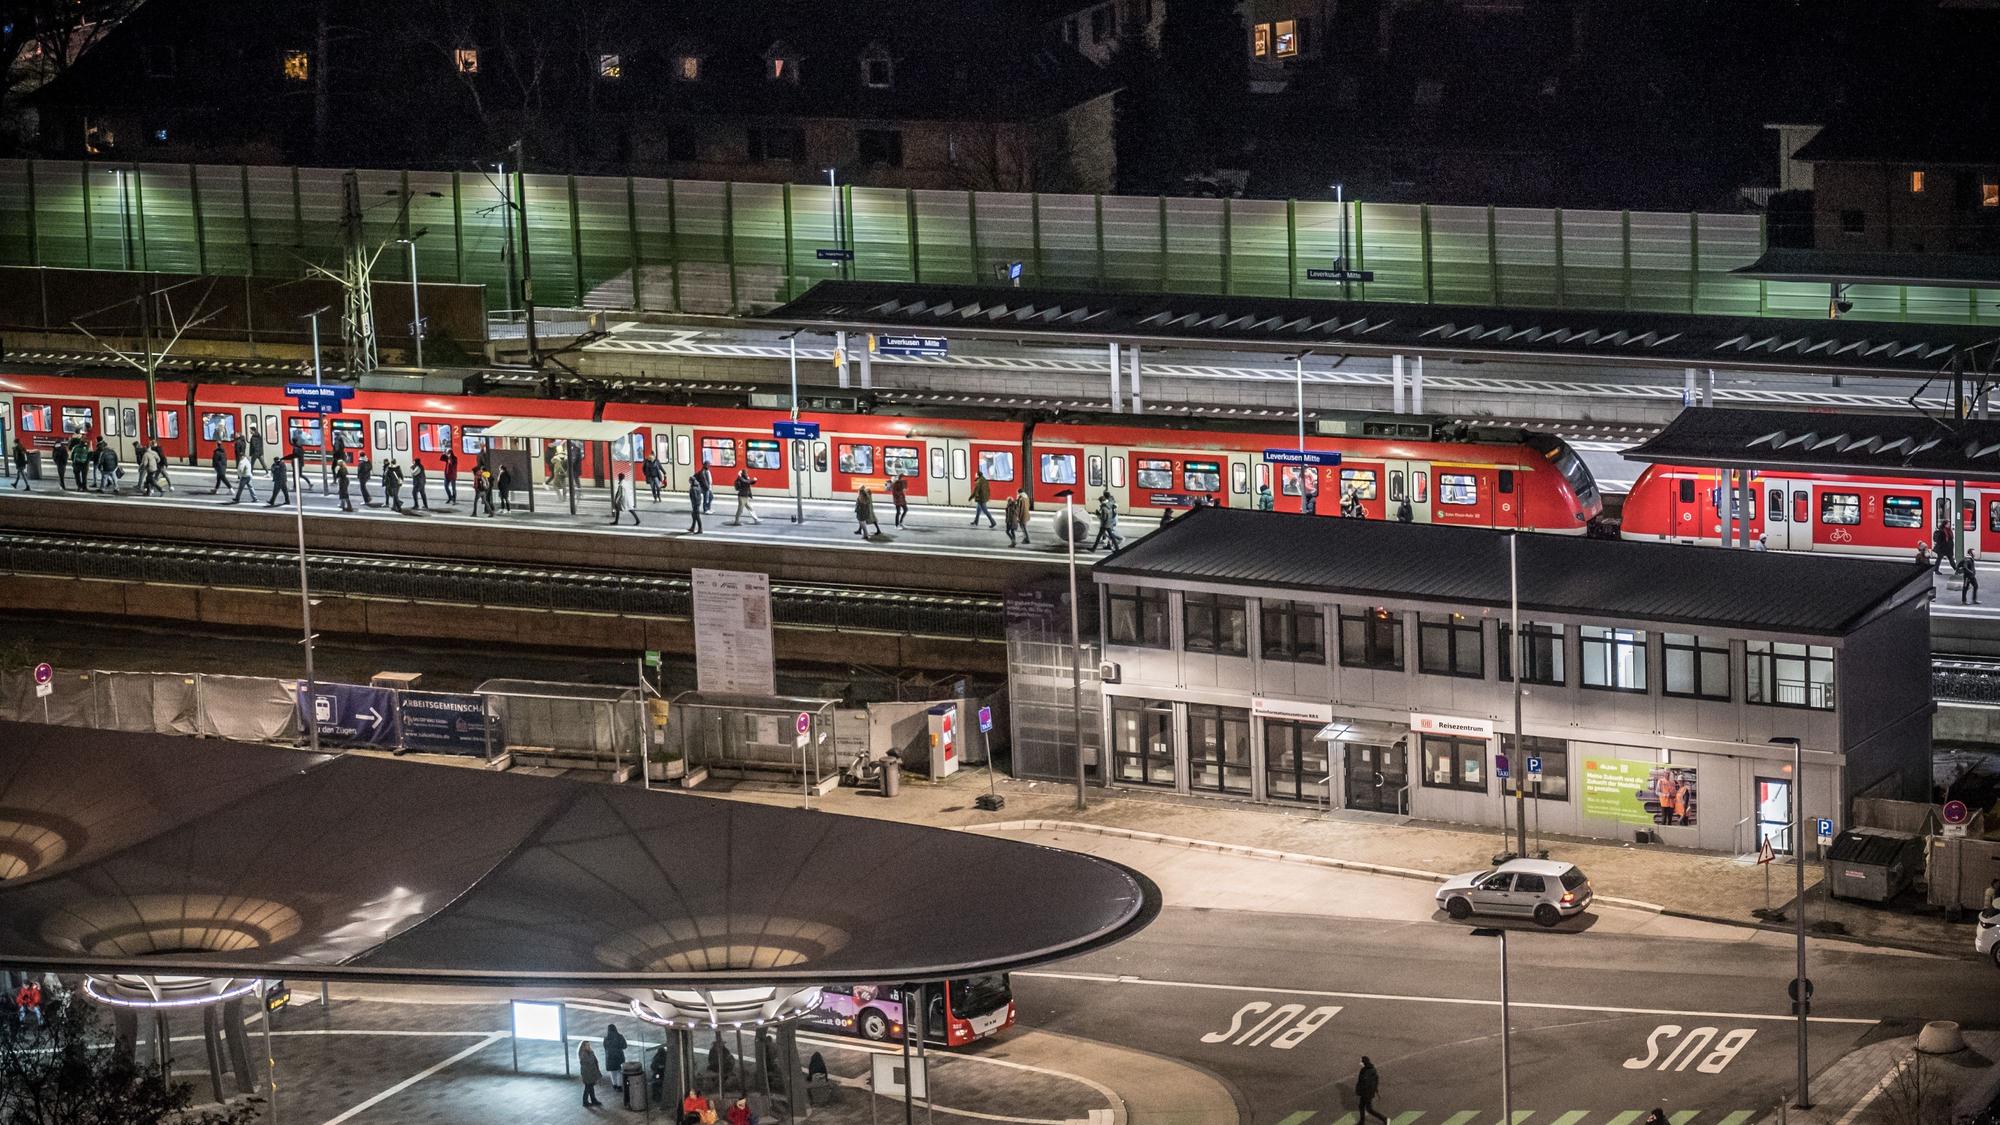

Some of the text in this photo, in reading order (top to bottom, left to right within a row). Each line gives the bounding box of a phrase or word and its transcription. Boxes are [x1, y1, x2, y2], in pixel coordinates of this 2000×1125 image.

[887, 338, 920, 346] Leverkusen
[287, 387, 335, 396] Leverkusen Mitte
[1266, 452, 1320, 462] Leverkusen Mitte
[1868, 495, 1875, 506] 2
[336, 726, 357, 735] Zügen
[1438, 722, 1483, 732] Reisezentrum
[1530, 759, 1539, 771] P
[1820, 821, 1829, 833] P
[1200, 1001, 1344, 1049] BUS
[1623, 1025, 1757, 1073] BUS
